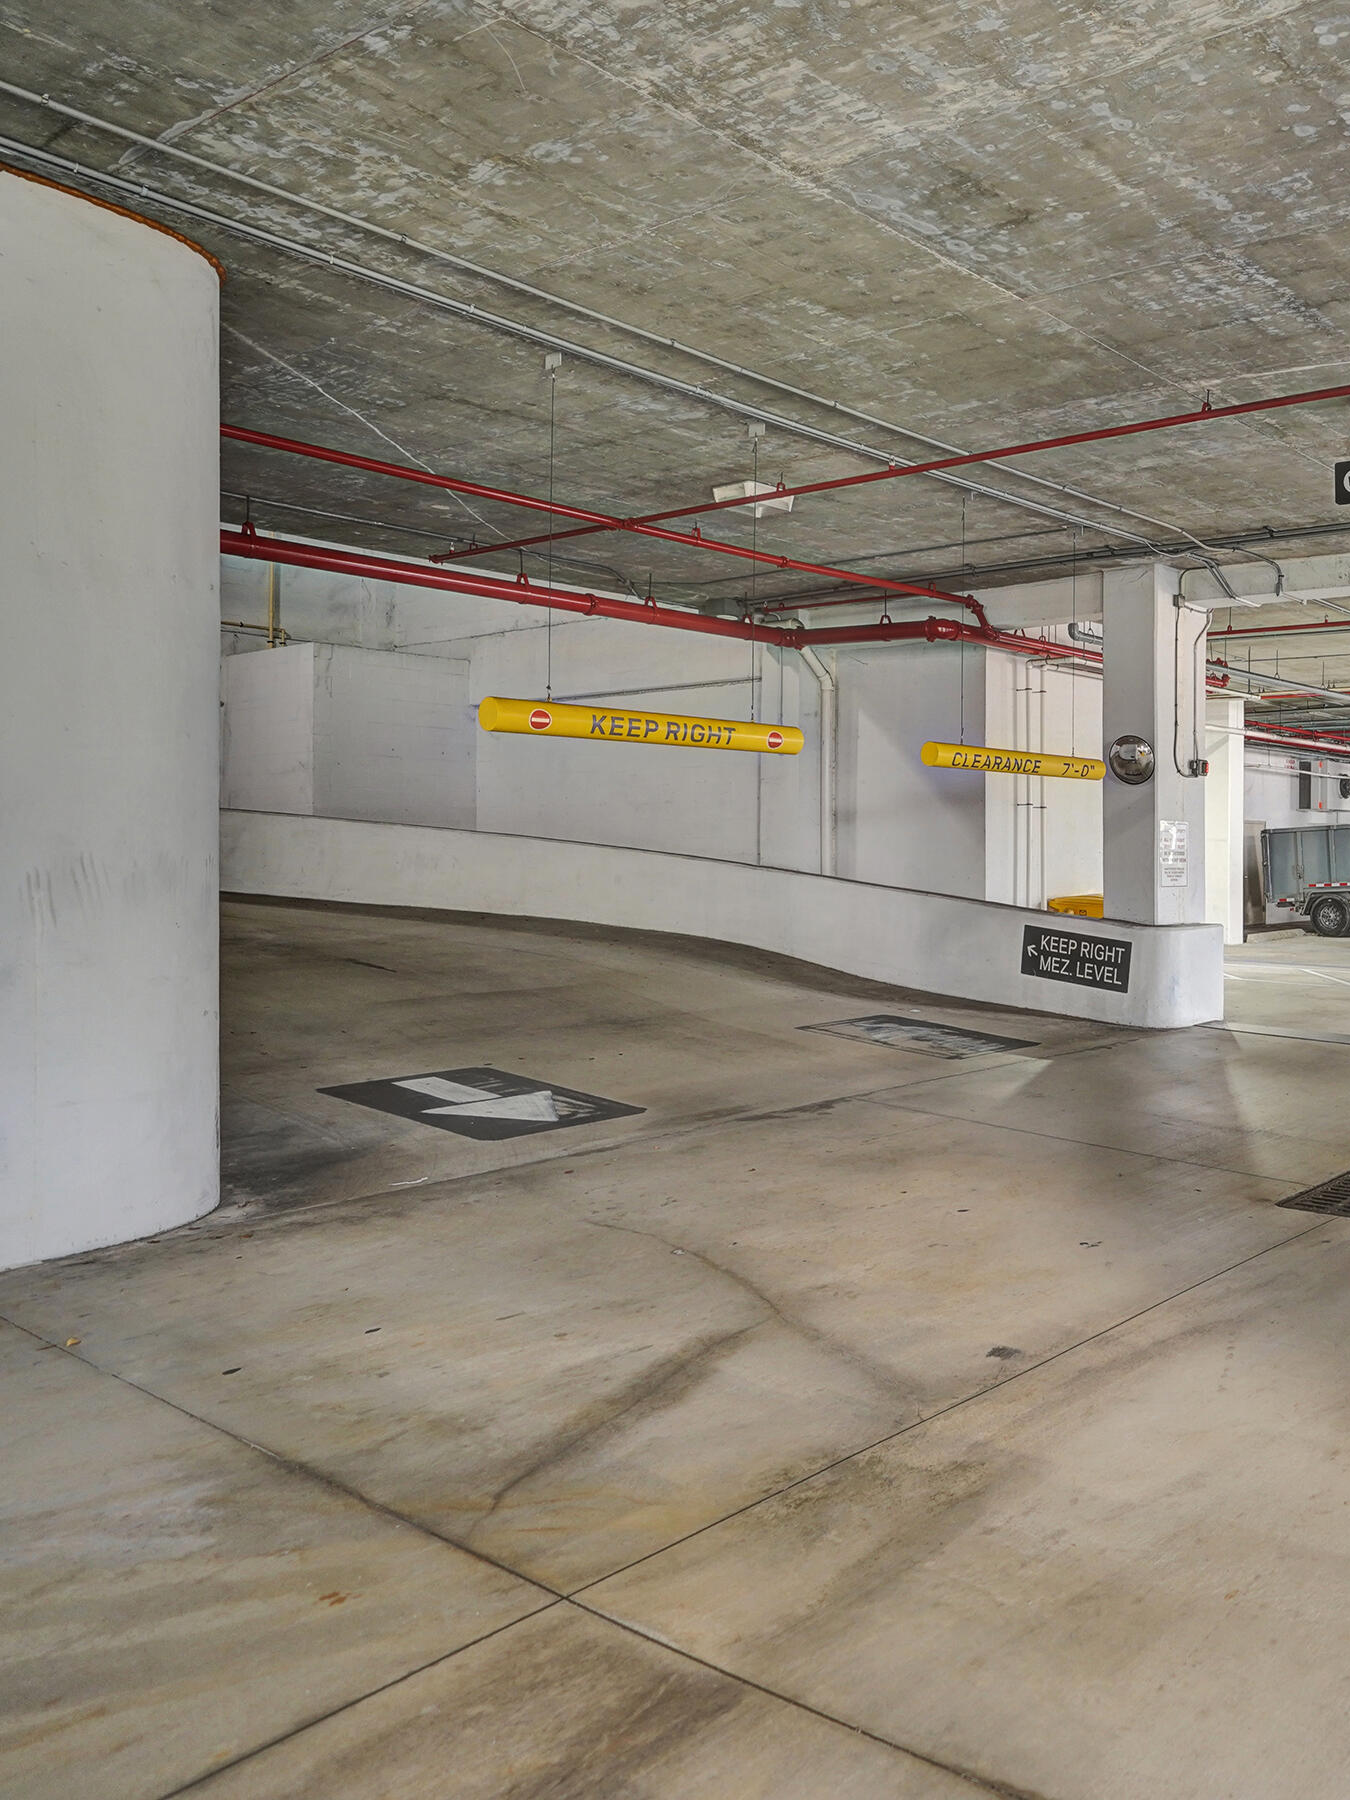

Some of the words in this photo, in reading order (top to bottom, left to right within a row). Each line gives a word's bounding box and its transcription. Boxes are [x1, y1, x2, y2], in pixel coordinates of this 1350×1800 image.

[590, 714, 660, 738] KEEP
[665, 721, 736, 745] RIGHT
[951, 752, 1042, 774] CLEARANCE
[1040, 934, 1077, 955] KEEP
[1080, 941, 1125, 964] RIGHT
[1039, 955, 1072, 976] MEZ.
[1076, 961, 1122, 985] LEVEL
